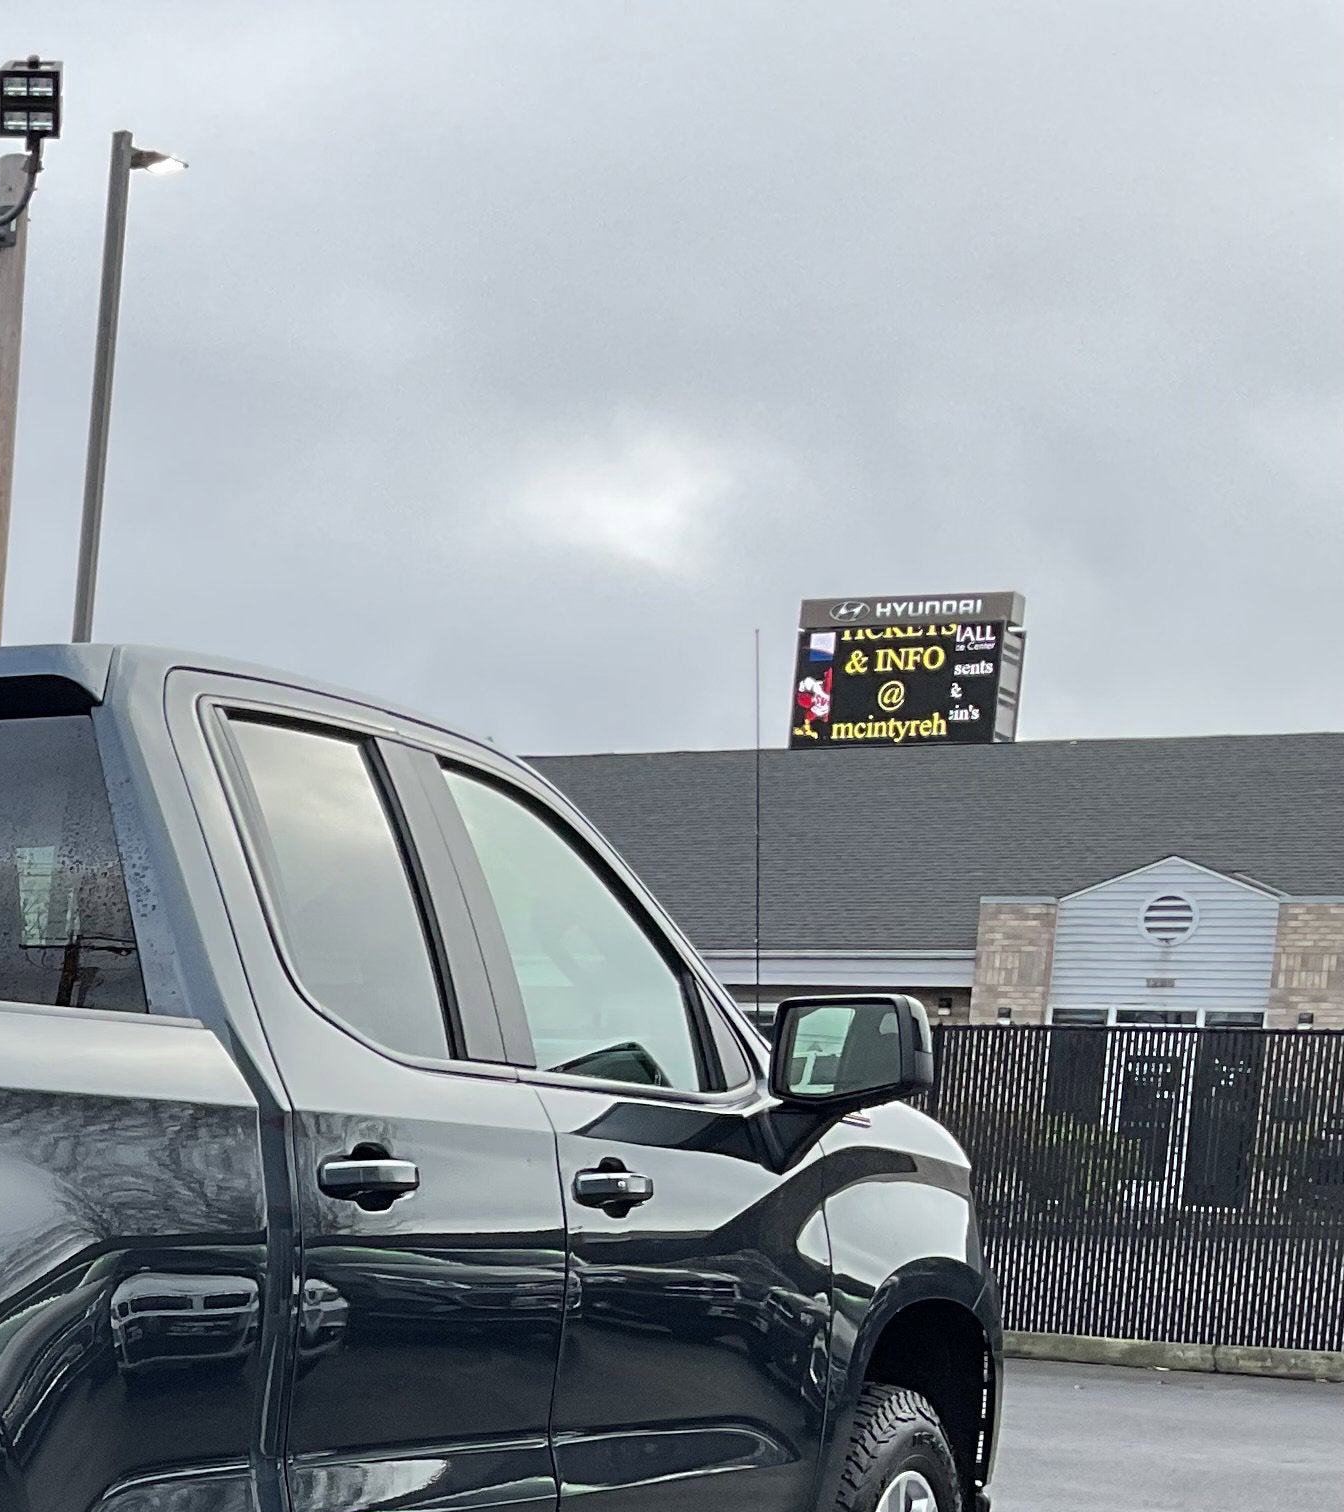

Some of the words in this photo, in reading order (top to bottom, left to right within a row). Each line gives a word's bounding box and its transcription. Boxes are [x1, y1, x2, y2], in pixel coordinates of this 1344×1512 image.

[875, 599, 982, 617] HYUNDAI
[844, 650, 868, 675] &
[874, 645, 945, 672] INFO
[877, 680, 905, 711] @
[831, 712, 947, 743] mcintyreh
